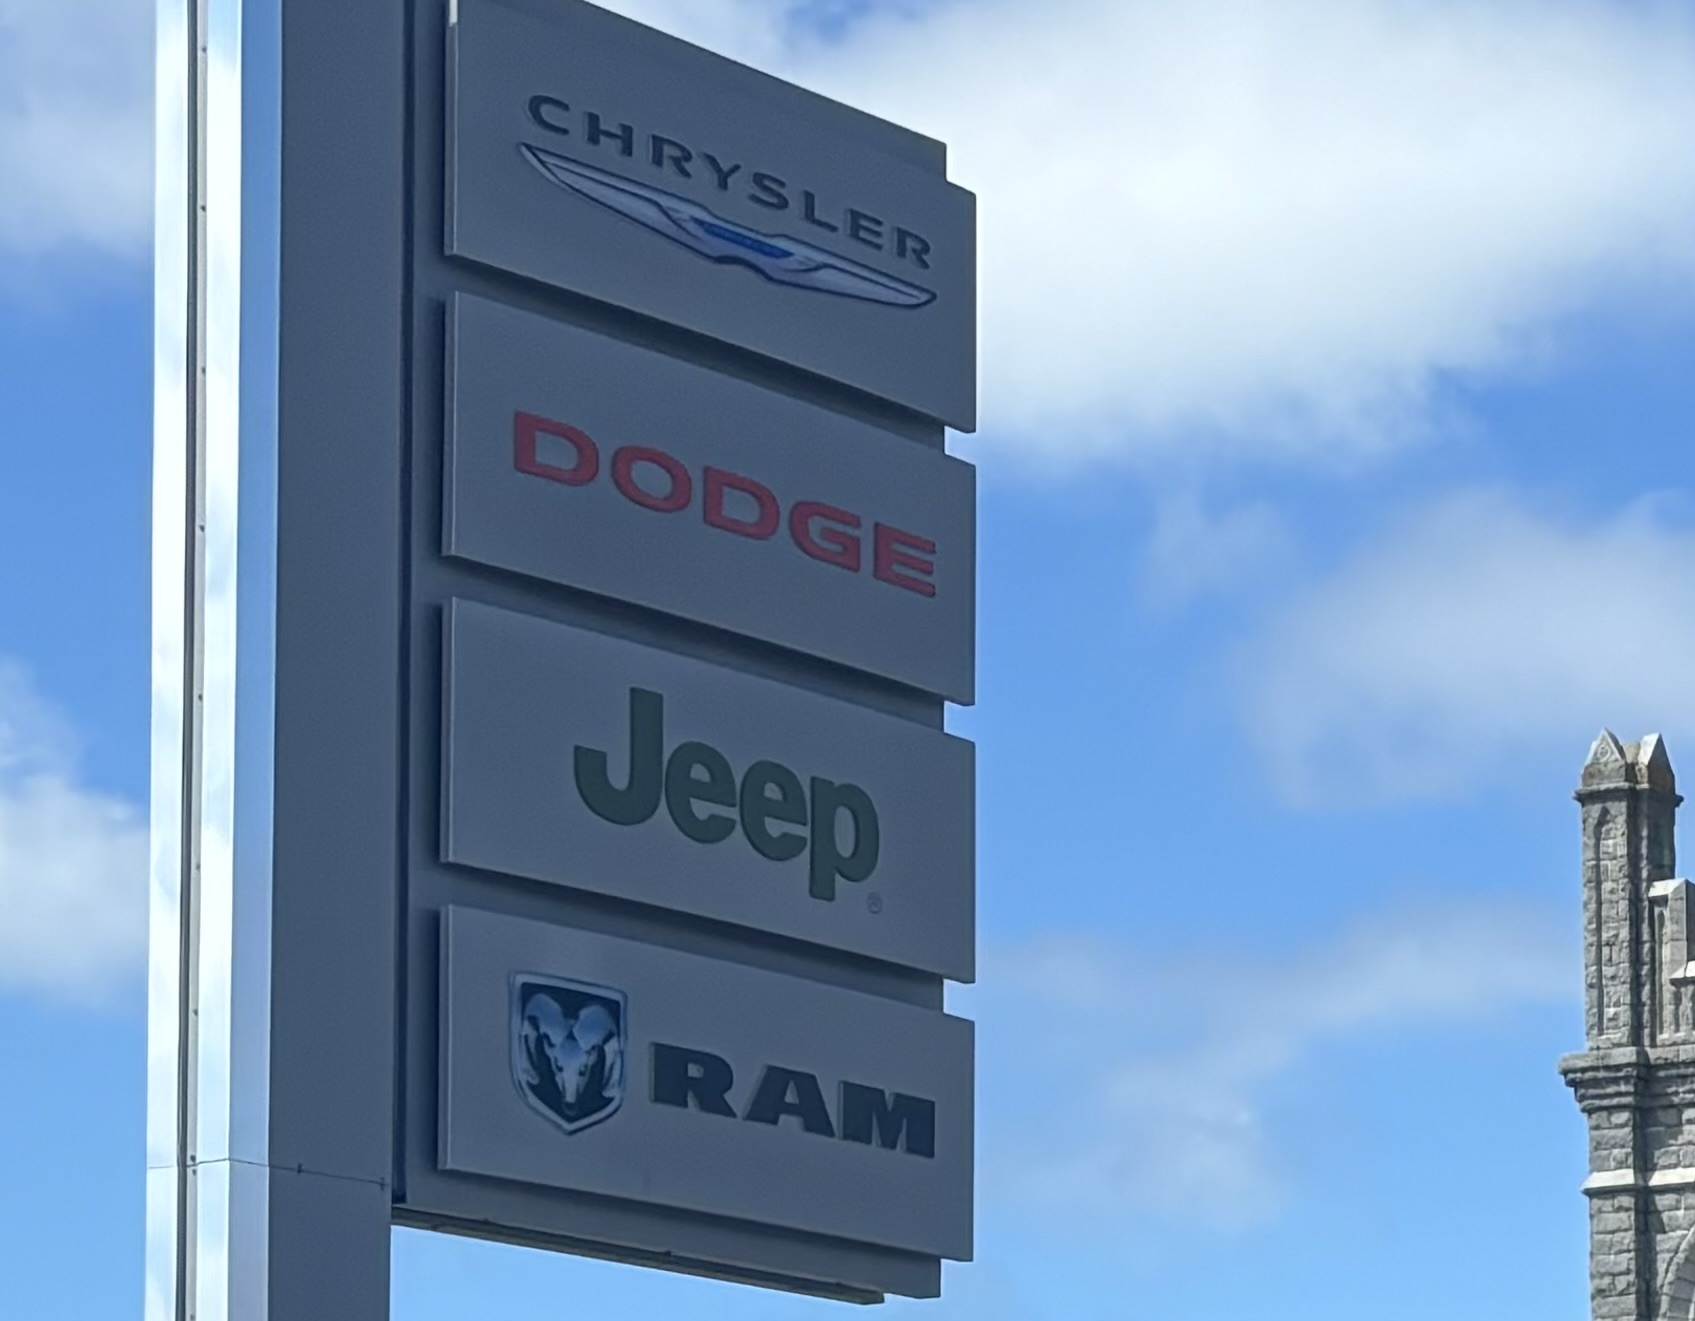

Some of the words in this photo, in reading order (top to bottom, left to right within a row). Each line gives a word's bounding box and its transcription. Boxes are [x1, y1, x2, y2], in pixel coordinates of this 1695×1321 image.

[527, 94, 932, 270] CHRYSLER
[513, 410, 937, 599] DODGE
[573, 686, 880, 902] Jeep
[649, 1040, 936, 1160] RAM
